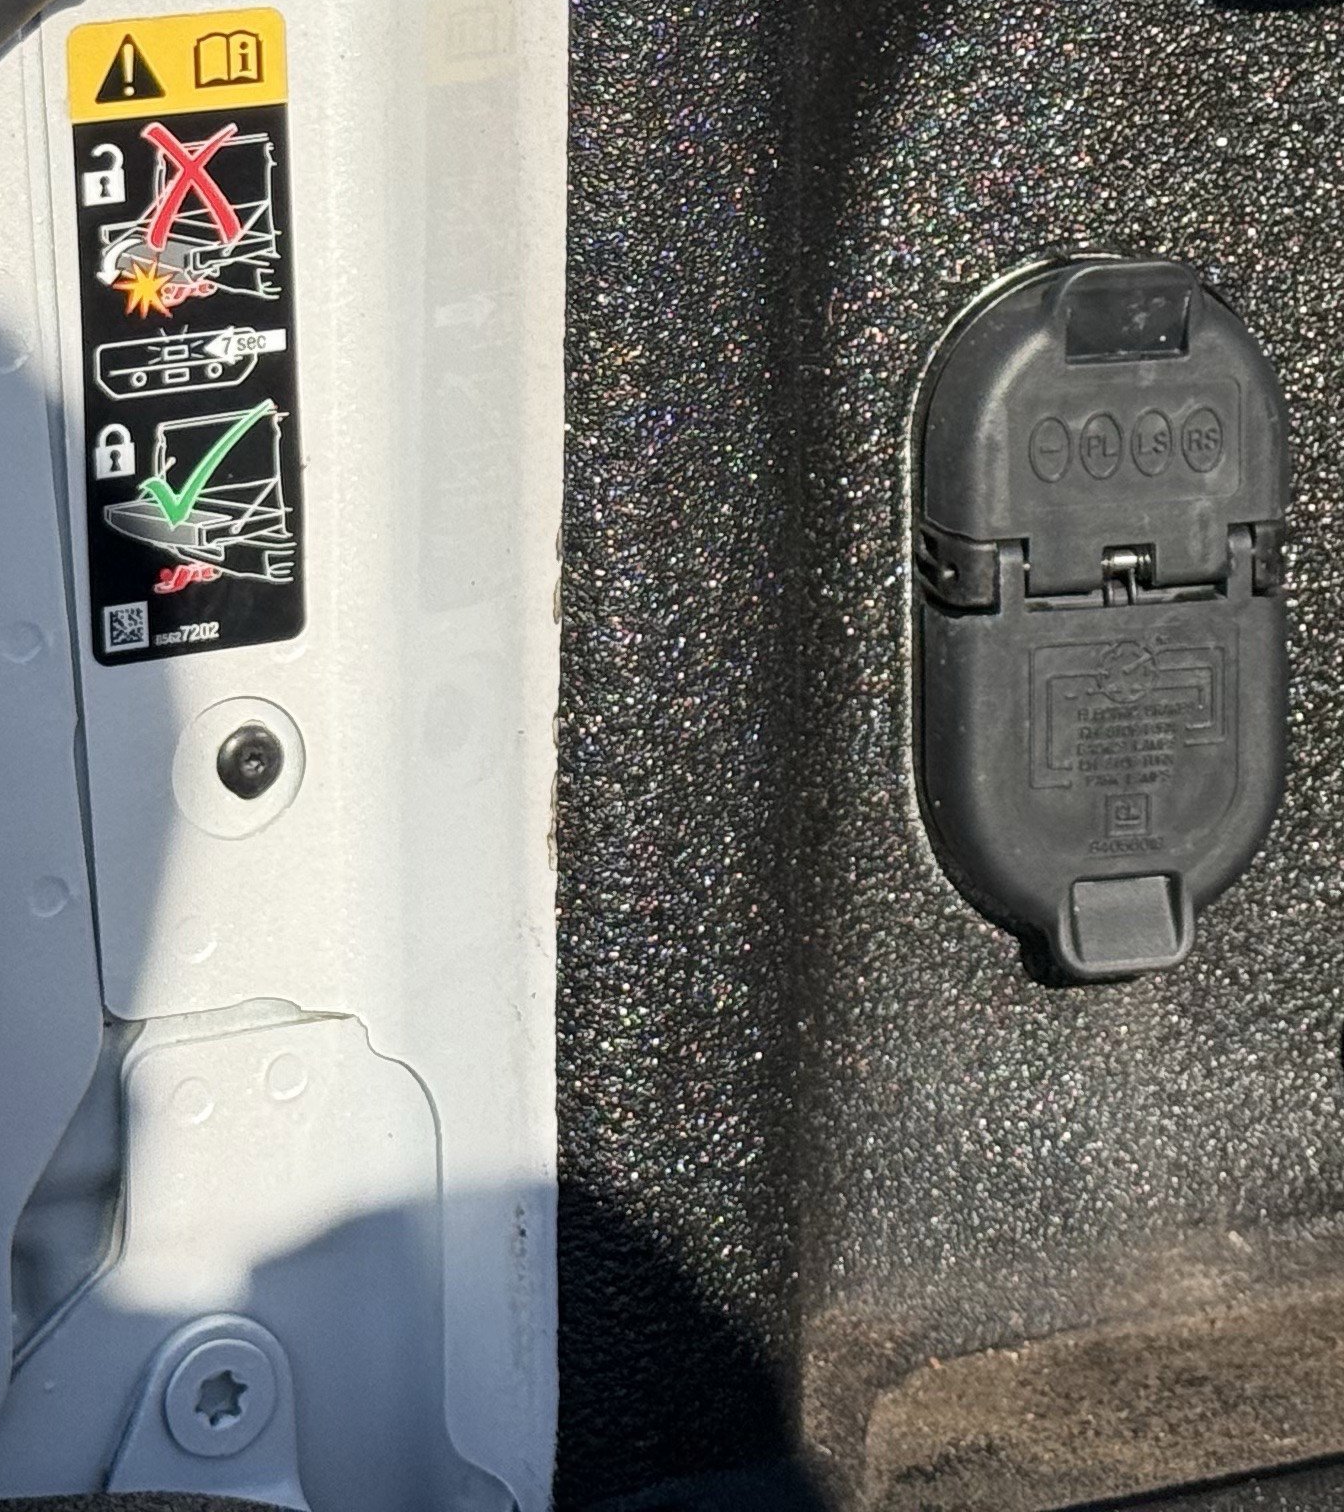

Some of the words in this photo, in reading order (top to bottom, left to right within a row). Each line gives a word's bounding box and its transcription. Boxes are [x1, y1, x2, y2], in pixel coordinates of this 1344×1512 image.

[222, 336, 232, 355] 7
[237, 334, 267, 352] sec
[1087, 434, 1118, 458] PL
[1137, 431, 1168, 456] LS
[1187, 427, 1219, 453] RS
